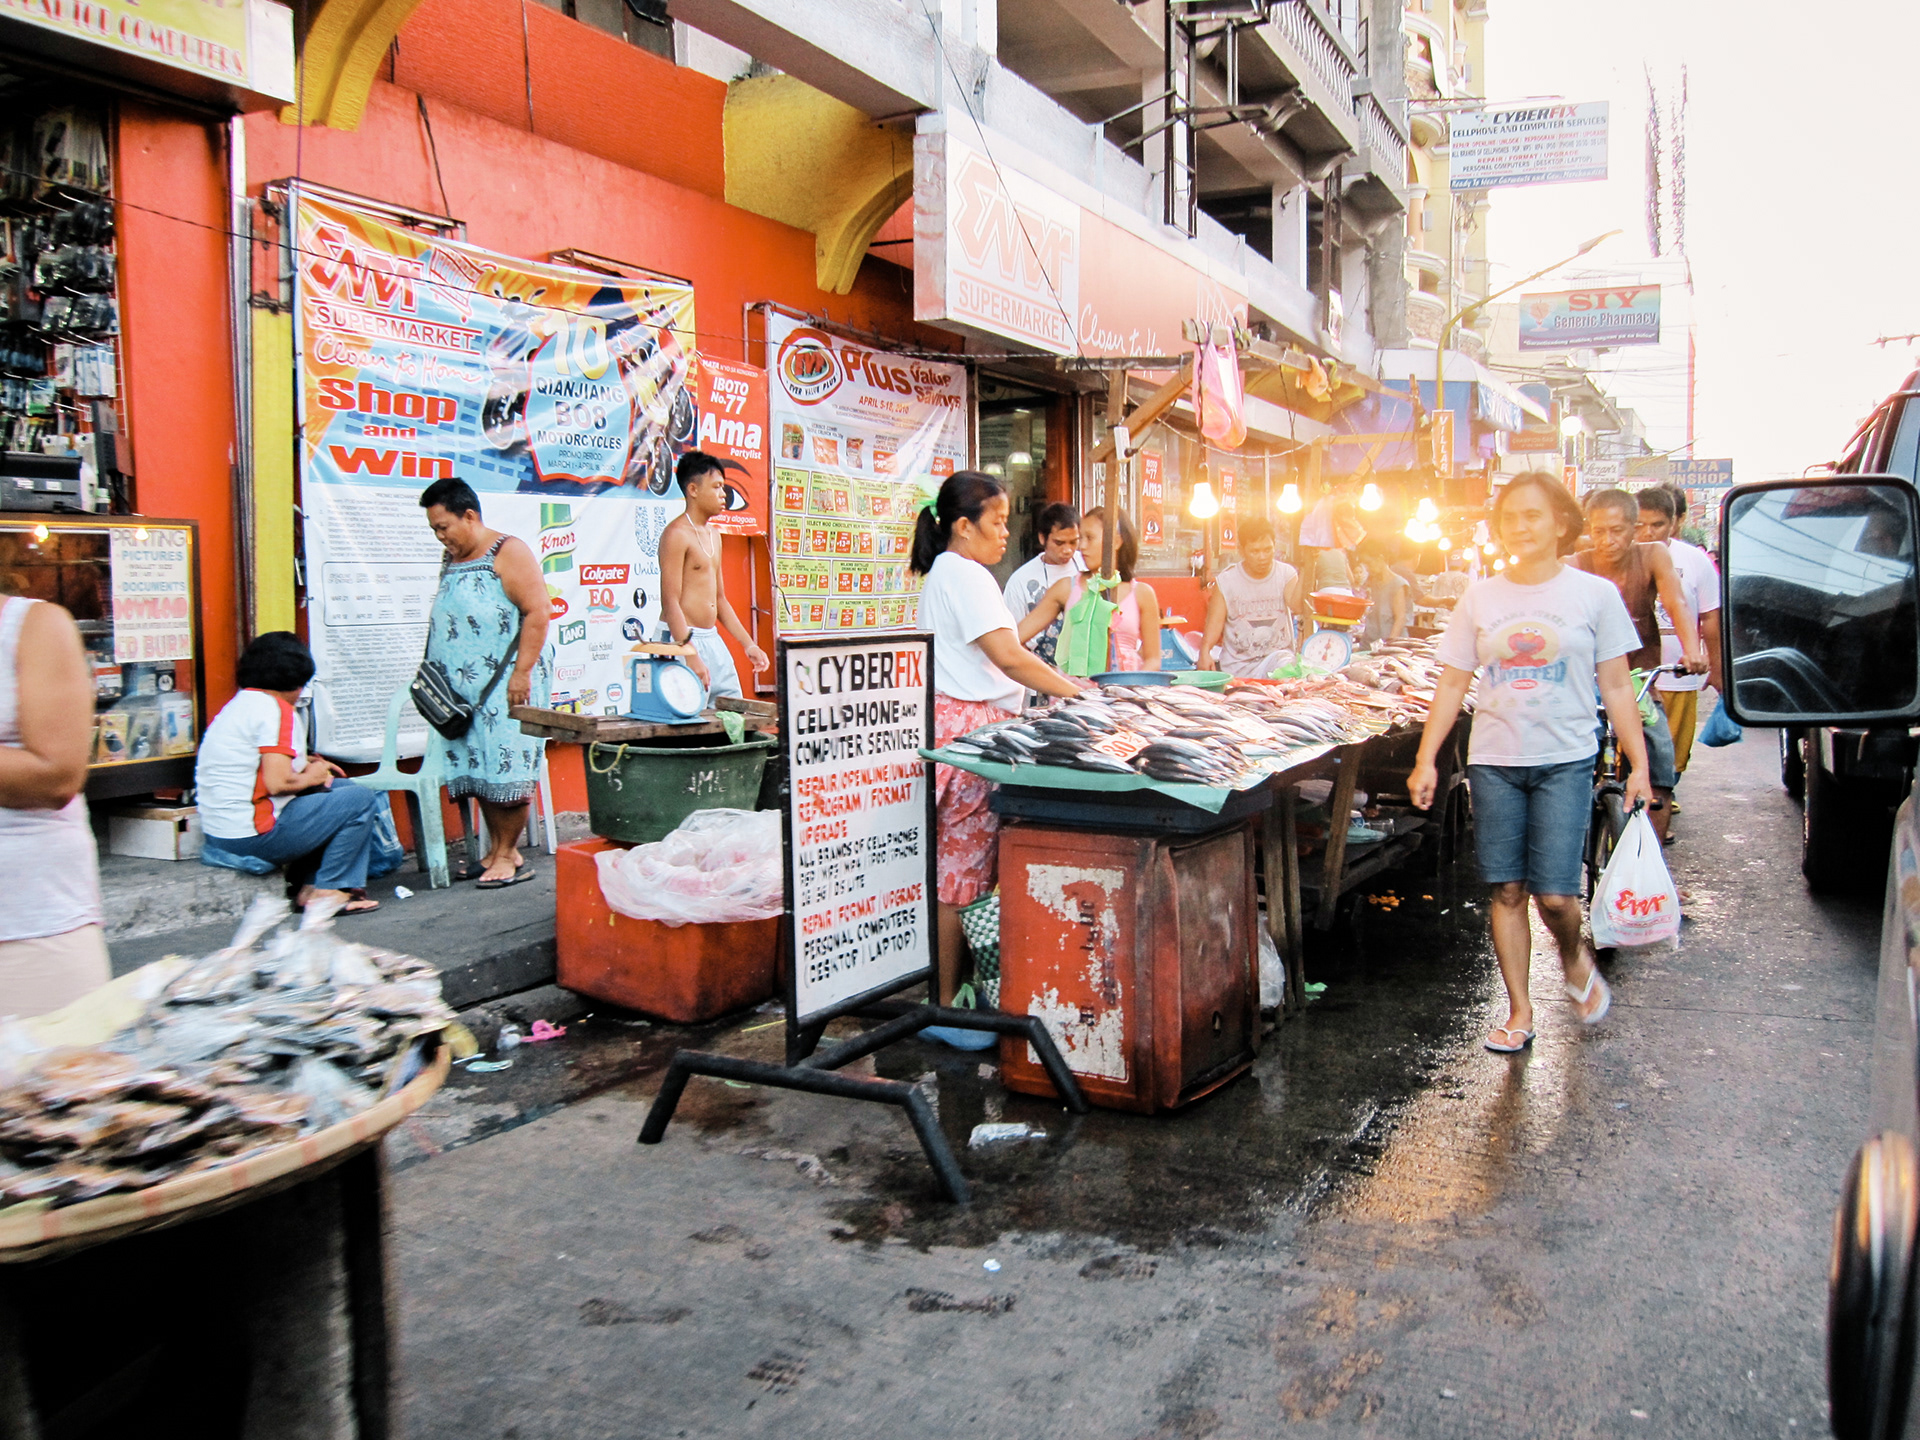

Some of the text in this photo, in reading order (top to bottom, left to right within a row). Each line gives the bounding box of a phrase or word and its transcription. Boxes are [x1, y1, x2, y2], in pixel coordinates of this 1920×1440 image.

[1493, 105, 1579, 125] CYBERFIX
[1452, 116, 1607, 138] CELLPHONE AND COMPUTER SERVICES
[958, 279, 1068, 342] SUPERMARKET
[1568, 290, 1641, 312] SIY
[316, 304, 477, 351] SUPERMARKET
[1554, 311, 1657, 330] Generic Pharmacy
[541, 310, 610, 380] 10
[840, 344, 913, 396] Plus
[910, 365, 952, 388] Value
[535, 377, 625, 403] QIANJIANG
[712, 376, 750, 397] IBOTO
[318, 376, 458, 425] Shop
[858, 395, 878, 410] APRIL
[363, 424, 416, 440] and
[537, 429, 623, 450] MOTORCYCLES
[700, 411, 763, 450] Ama
[729, 447, 762, 460] Partylist
[1438, 415, 1449, 473] VILLAR
[327, 444, 454, 480] Win
[1142, 479, 1162, 499] Ama
[112, 529, 186, 548] PRTING
[540, 531, 576, 554] Knorr
[121, 550, 184, 562] PICTURES
[581, 566, 625, 583] Colgate
[122, 581, 186, 592] DOCUMENTS
[588, 587, 615, 609] EQ
[560, 624, 585, 645] TANG
[818, 651, 924, 695] CYBERFIX
[796, 700, 918, 735] CELLPHONE AND
[796, 728, 920, 766] COMPUTER SERVICES
[1101, 738, 1137, 758] 30
[798, 792, 862, 823] REPROGRAM
[871, 782, 912, 808] FORMAT
[799, 819, 848, 847] UPGRADE
[799, 826, 919, 868] ALL BRANDS OF CELLPHONES
[802, 909, 833, 936] REPAIR
[838, 895, 877, 923] FORMAT
[883, 882, 923, 910] UPGRADE
[803, 907, 917, 962] PERSONAL COMPUTERS
